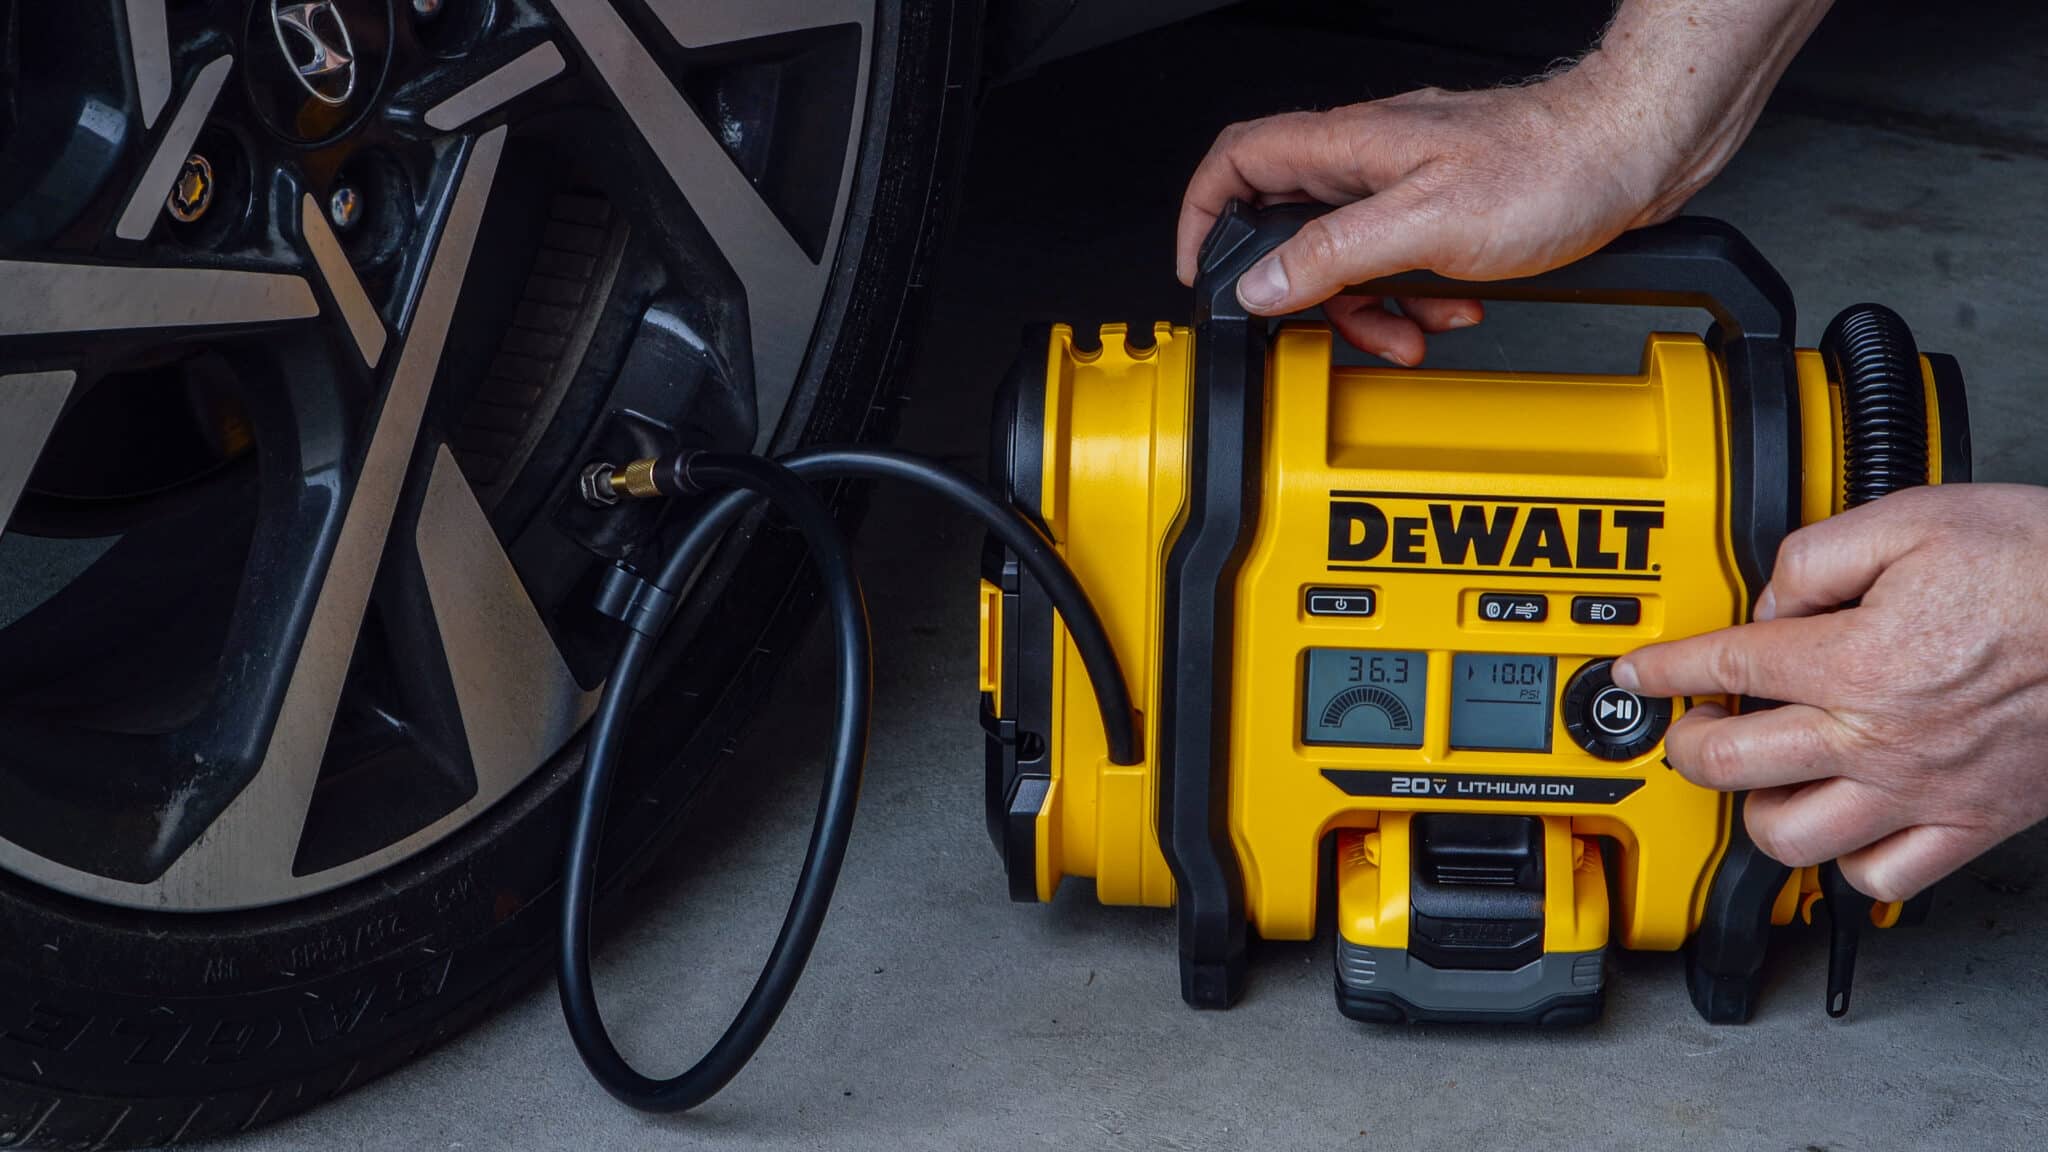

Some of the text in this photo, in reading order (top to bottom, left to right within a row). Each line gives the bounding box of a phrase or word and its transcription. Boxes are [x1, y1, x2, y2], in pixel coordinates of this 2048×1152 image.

[1348, 656, 1408, 683] 36.3
[1492, 664, 1535, 685] 10.0
[1520, 689, 1540, 700] PSI
[1457, 781, 1536, 795] LITHIUM
[1541, 783, 1574, 796] ION
